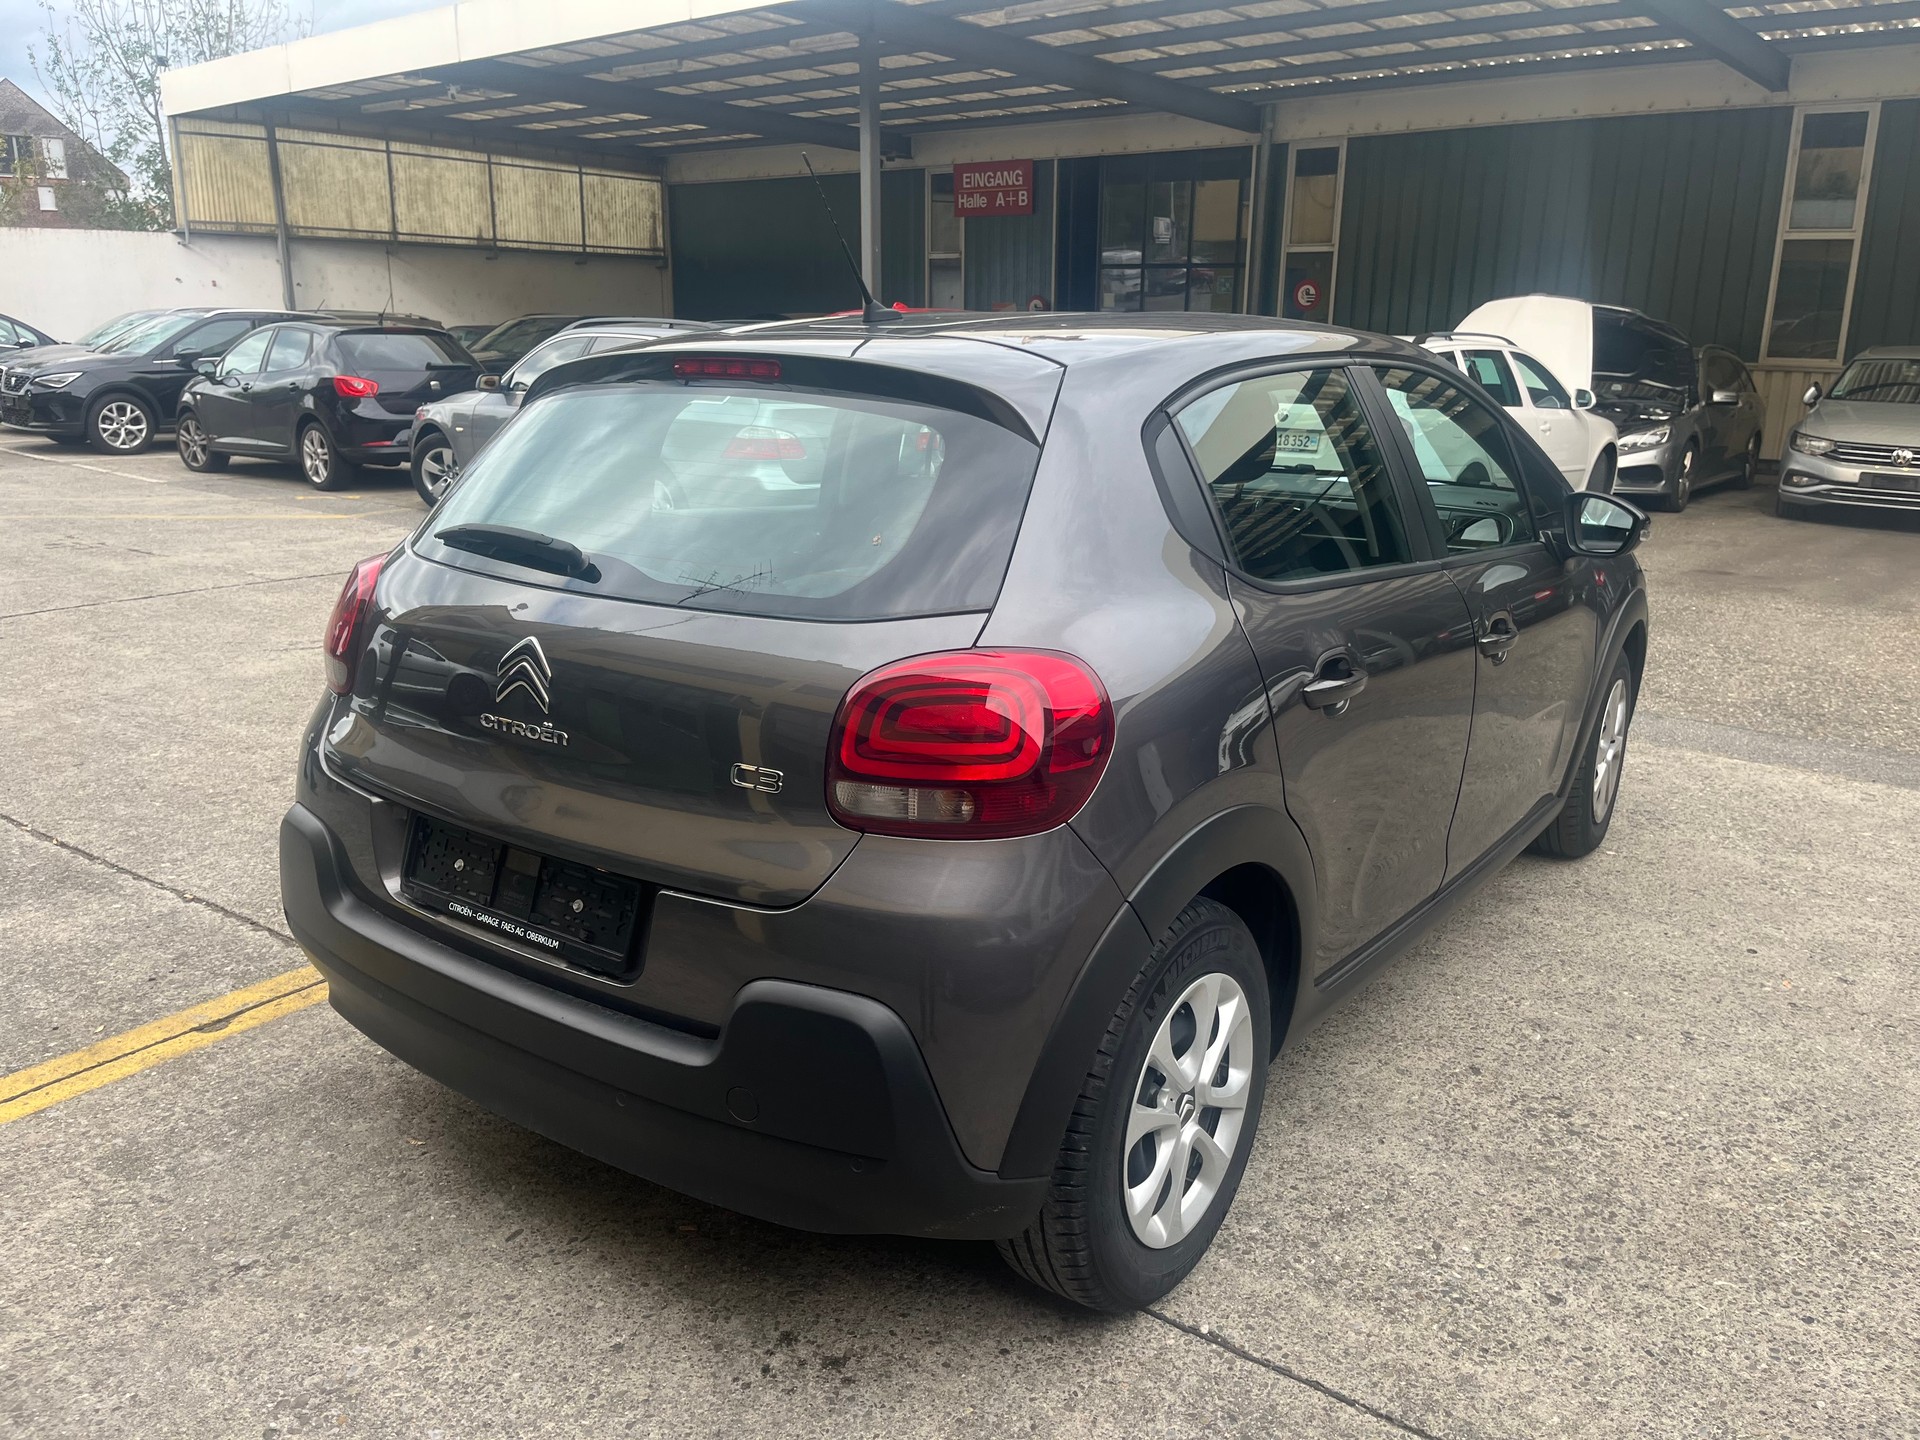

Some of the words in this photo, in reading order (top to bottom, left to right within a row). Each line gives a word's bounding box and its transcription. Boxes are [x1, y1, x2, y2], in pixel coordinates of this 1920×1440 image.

[962, 170, 1024, 188] EINGANG
[958, 193, 988, 209] Halle
[995, 191, 1029, 207] A+B
[730, 762, 784, 794] C3
[476, 912, 500, 928] GARAGE
[500, 921, 515, 933] FAES
[515, 926, 525, 937] AG
[526, 930, 559, 949] OBERKULM
